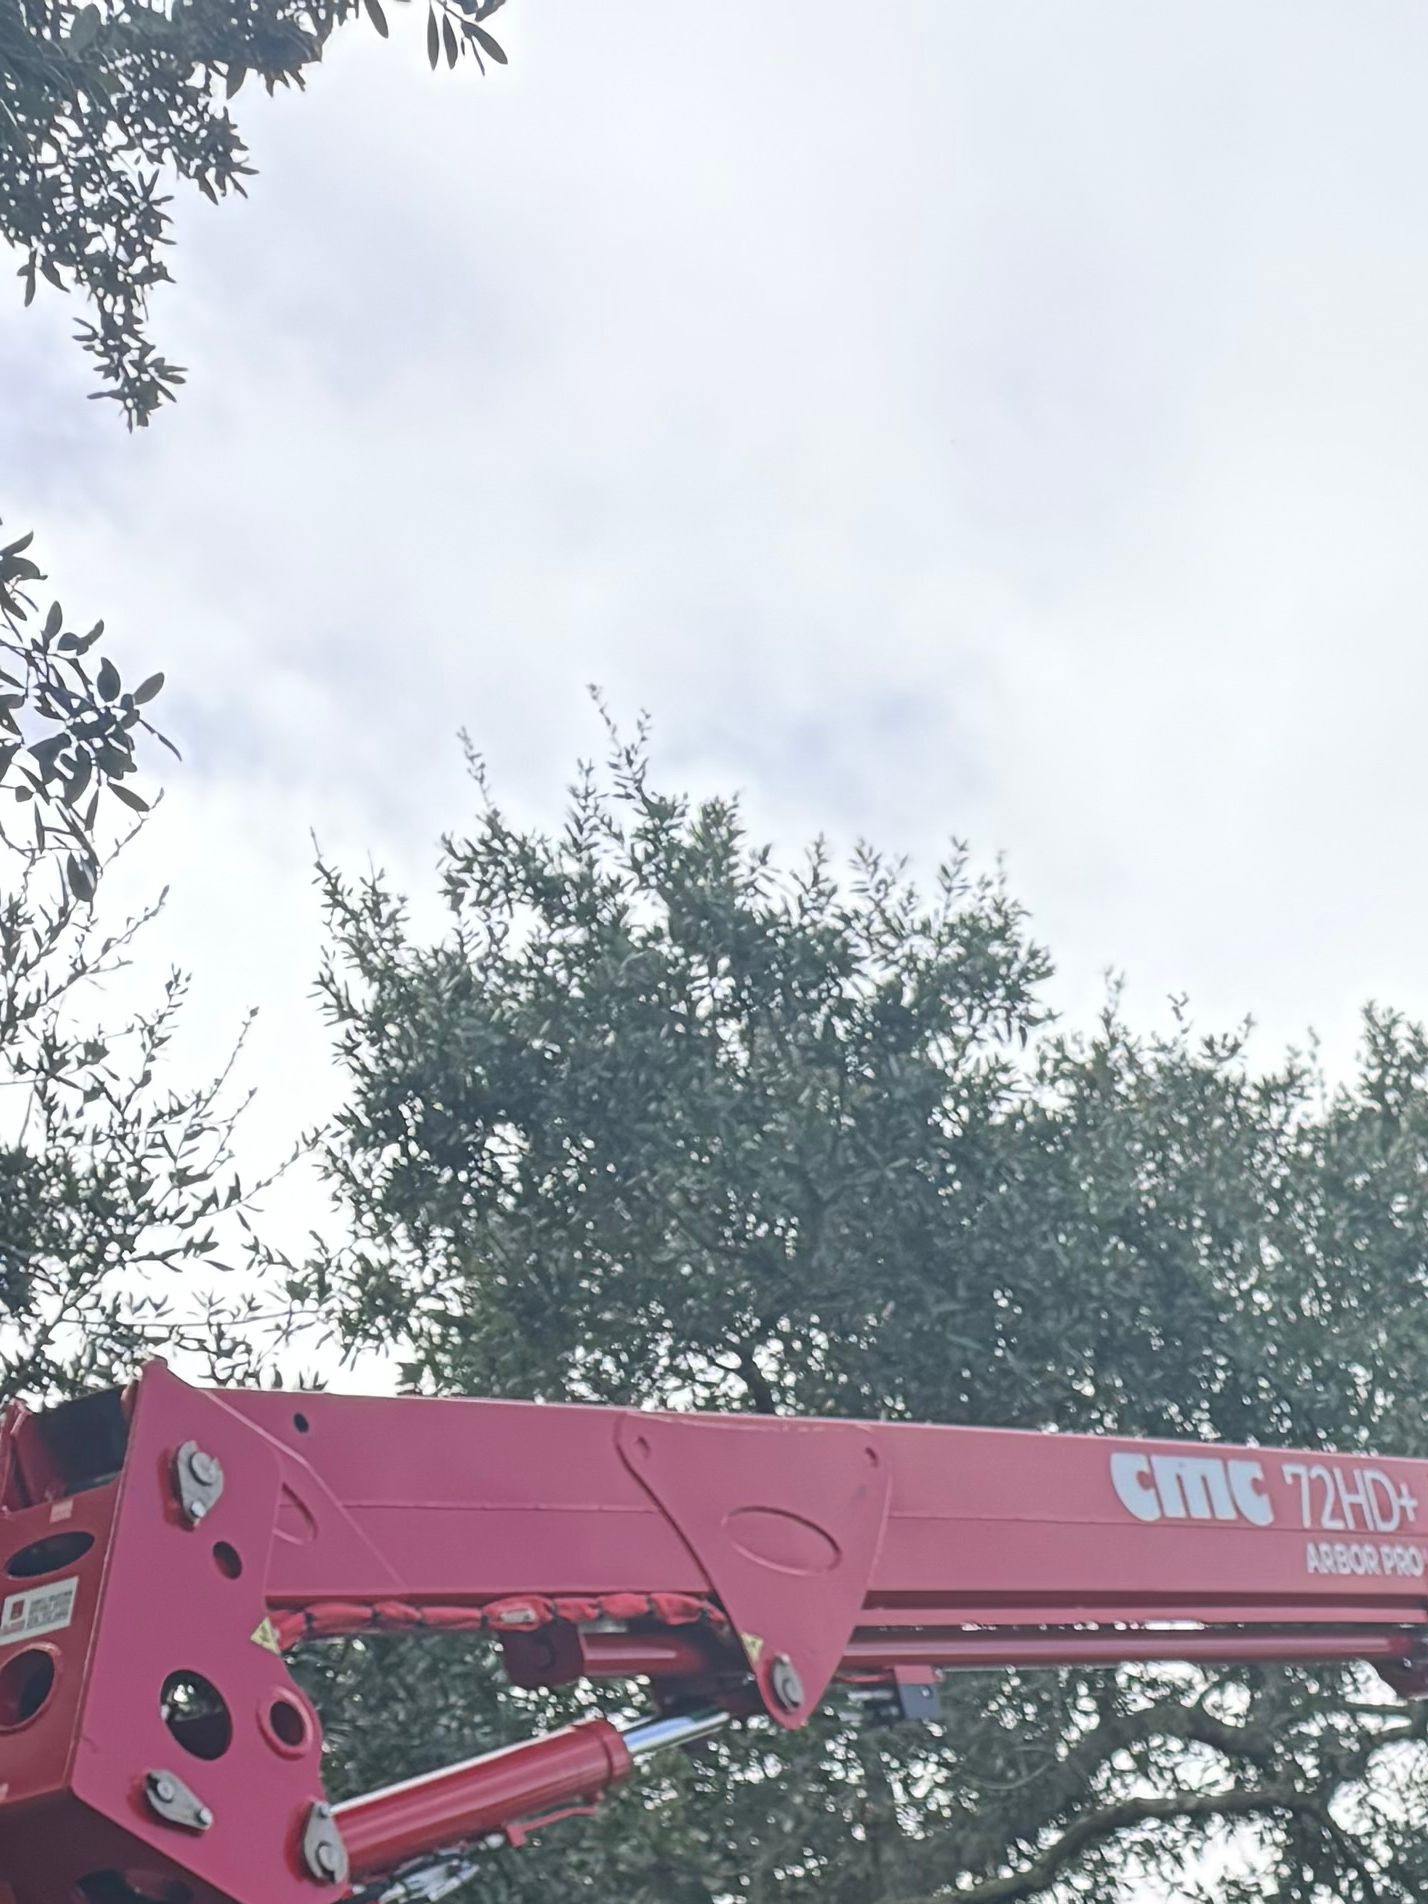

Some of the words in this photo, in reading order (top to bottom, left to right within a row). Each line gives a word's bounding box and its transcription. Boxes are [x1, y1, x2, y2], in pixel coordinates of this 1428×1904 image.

[1281, 1463, 1418, 1532] 72HD+
[1306, 1542, 1380, 1576] ARBOR
[1380, 1543, 1424, 1577] PRO
